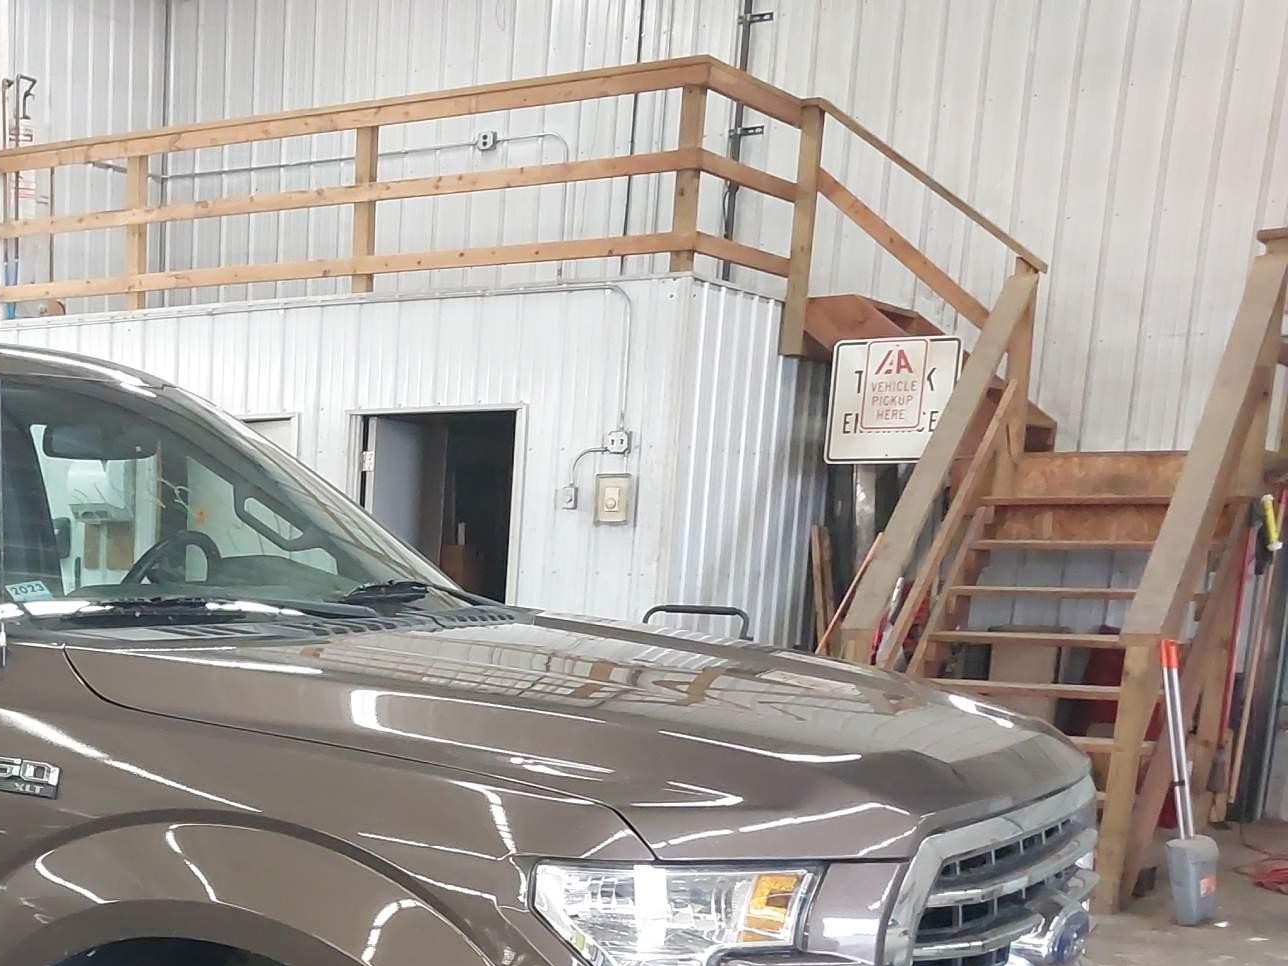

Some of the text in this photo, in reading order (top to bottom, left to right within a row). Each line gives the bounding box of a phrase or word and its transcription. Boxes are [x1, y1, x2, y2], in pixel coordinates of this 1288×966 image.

[871, 380, 918, 393] VEHICLE
[871, 395, 914, 406] PICKUP
[876, 408, 905, 421] HERE
[10, 583, 45, 596] 2023
[13, 781, 45, 795] XLT
